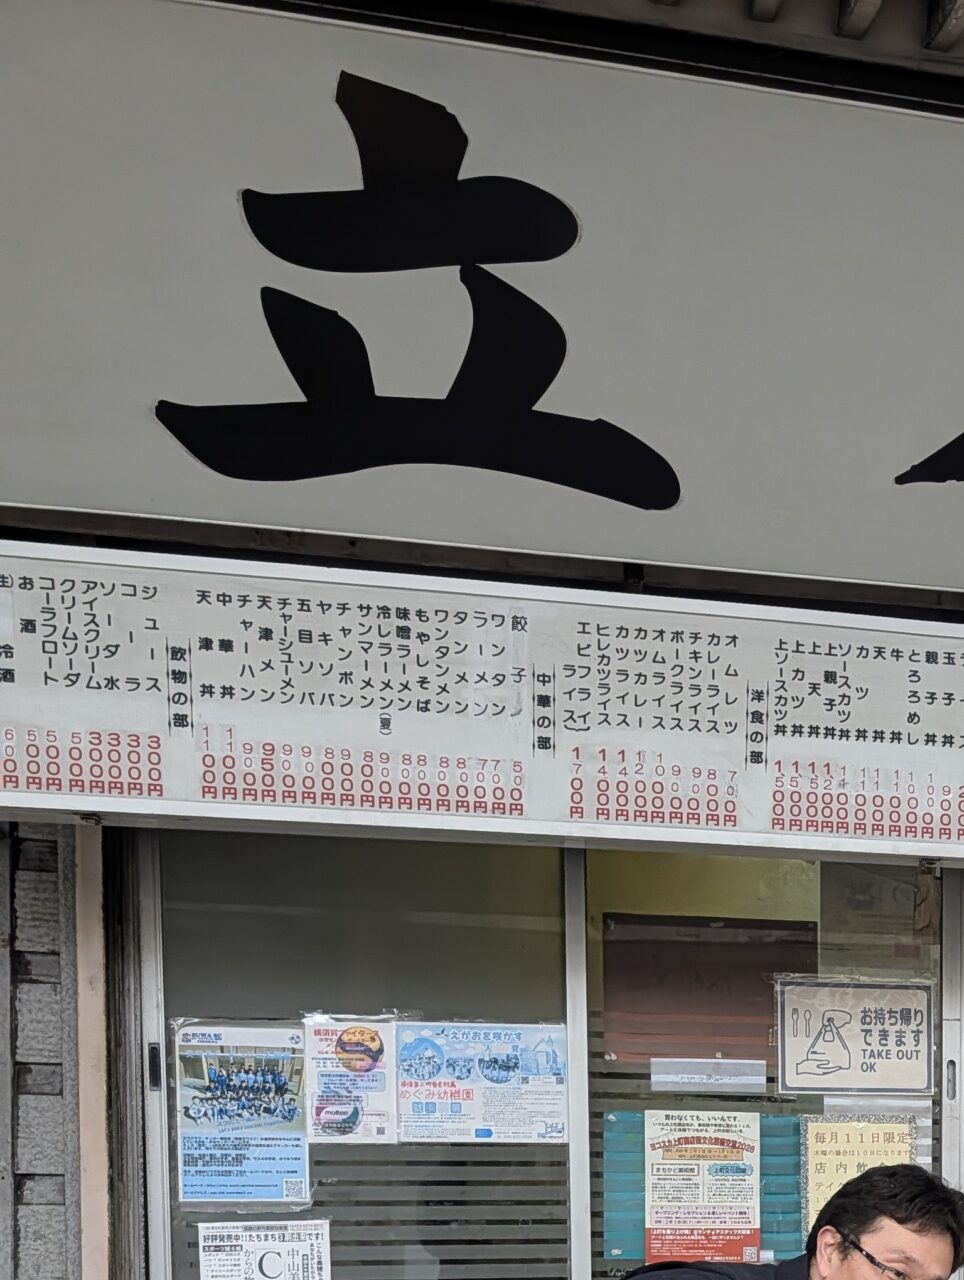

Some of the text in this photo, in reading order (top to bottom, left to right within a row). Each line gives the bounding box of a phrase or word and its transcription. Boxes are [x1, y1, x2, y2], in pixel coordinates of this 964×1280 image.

[39, 576, 59, 686] コーラフロート
[60, 578, 81, 688] クリームソーダ
[81, 580, 102, 690] アイスクリーム
[100, 582, 120, 691] ソーダ水
[121, 583, 141, 692] コーラ
[141, 585, 162, 693] ジュース
[196, 589, 215, 698] 天津丼
[216, 592, 235, 700] 中華丼
[237, 594, 255, 701] チャーハン
[257, 595, 275, 702] 天津メン
[277, 597, 295, 704] チャーシューメン
[297, 598, 315, 705] 五目ソバ
[316, 600, 335, 706] ヤキソバ
[336, 602, 353, 707] チャンポン
[357, 603, 374, 709] サンマーメン
[395, 607, 412, 711] 味噌ラーメン
[415, 608, 431, 712] もやしそば
[434, 610, 450, 714] ワンタンメン
[453, 611, 469, 714] タンメン
[473, 611, 489, 717] ラーメン
[491, 614, 506, 716] ワンタン
[511, 615, 528, 684] 餃子
[596, 623, 611, 726] ヒレカツライス
[615, 625, 630, 727] カツライス
[634, 626, 648, 728] カツカレー
[651, 628, 666, 730] オムライス
[670, 630, 685, 731] ポークライス
[688, 631, 702, 733] チキンライス
[170, 646, 189, 728] 飲物の部
[536, 673, 552, 750] 中華の部
[706, 633, 721, 733] カレーライス
[724, 634, 739, 735] オムレツ
[749, 688, 765, 765] 洋食の部
[774, 638, 789, 737] 上ソースカツ丼
[791, 640, 806, 738] 上カツ丼
[807, 641, 822, 739] 上天丼
[823, 643, 838, 740] 上親子丼
[837, 643, 851, 741] ソースカツ丼
[855, 645, 869, 743] カツ丼
[889, 647, 904, 745] 牛丼
[907, 650, 922, 746] とろろめし
[924, 651, 938, 747] 親子丼
[941, 651, 956, 748] 玉子丼
[860, 1007, 924, 1027] お持ち帰り
[860, 1028, 923, 1047] できます
[860, 1049, 921, 1060] TAKE OUT
[860, 1061, 877, 1073] OK
